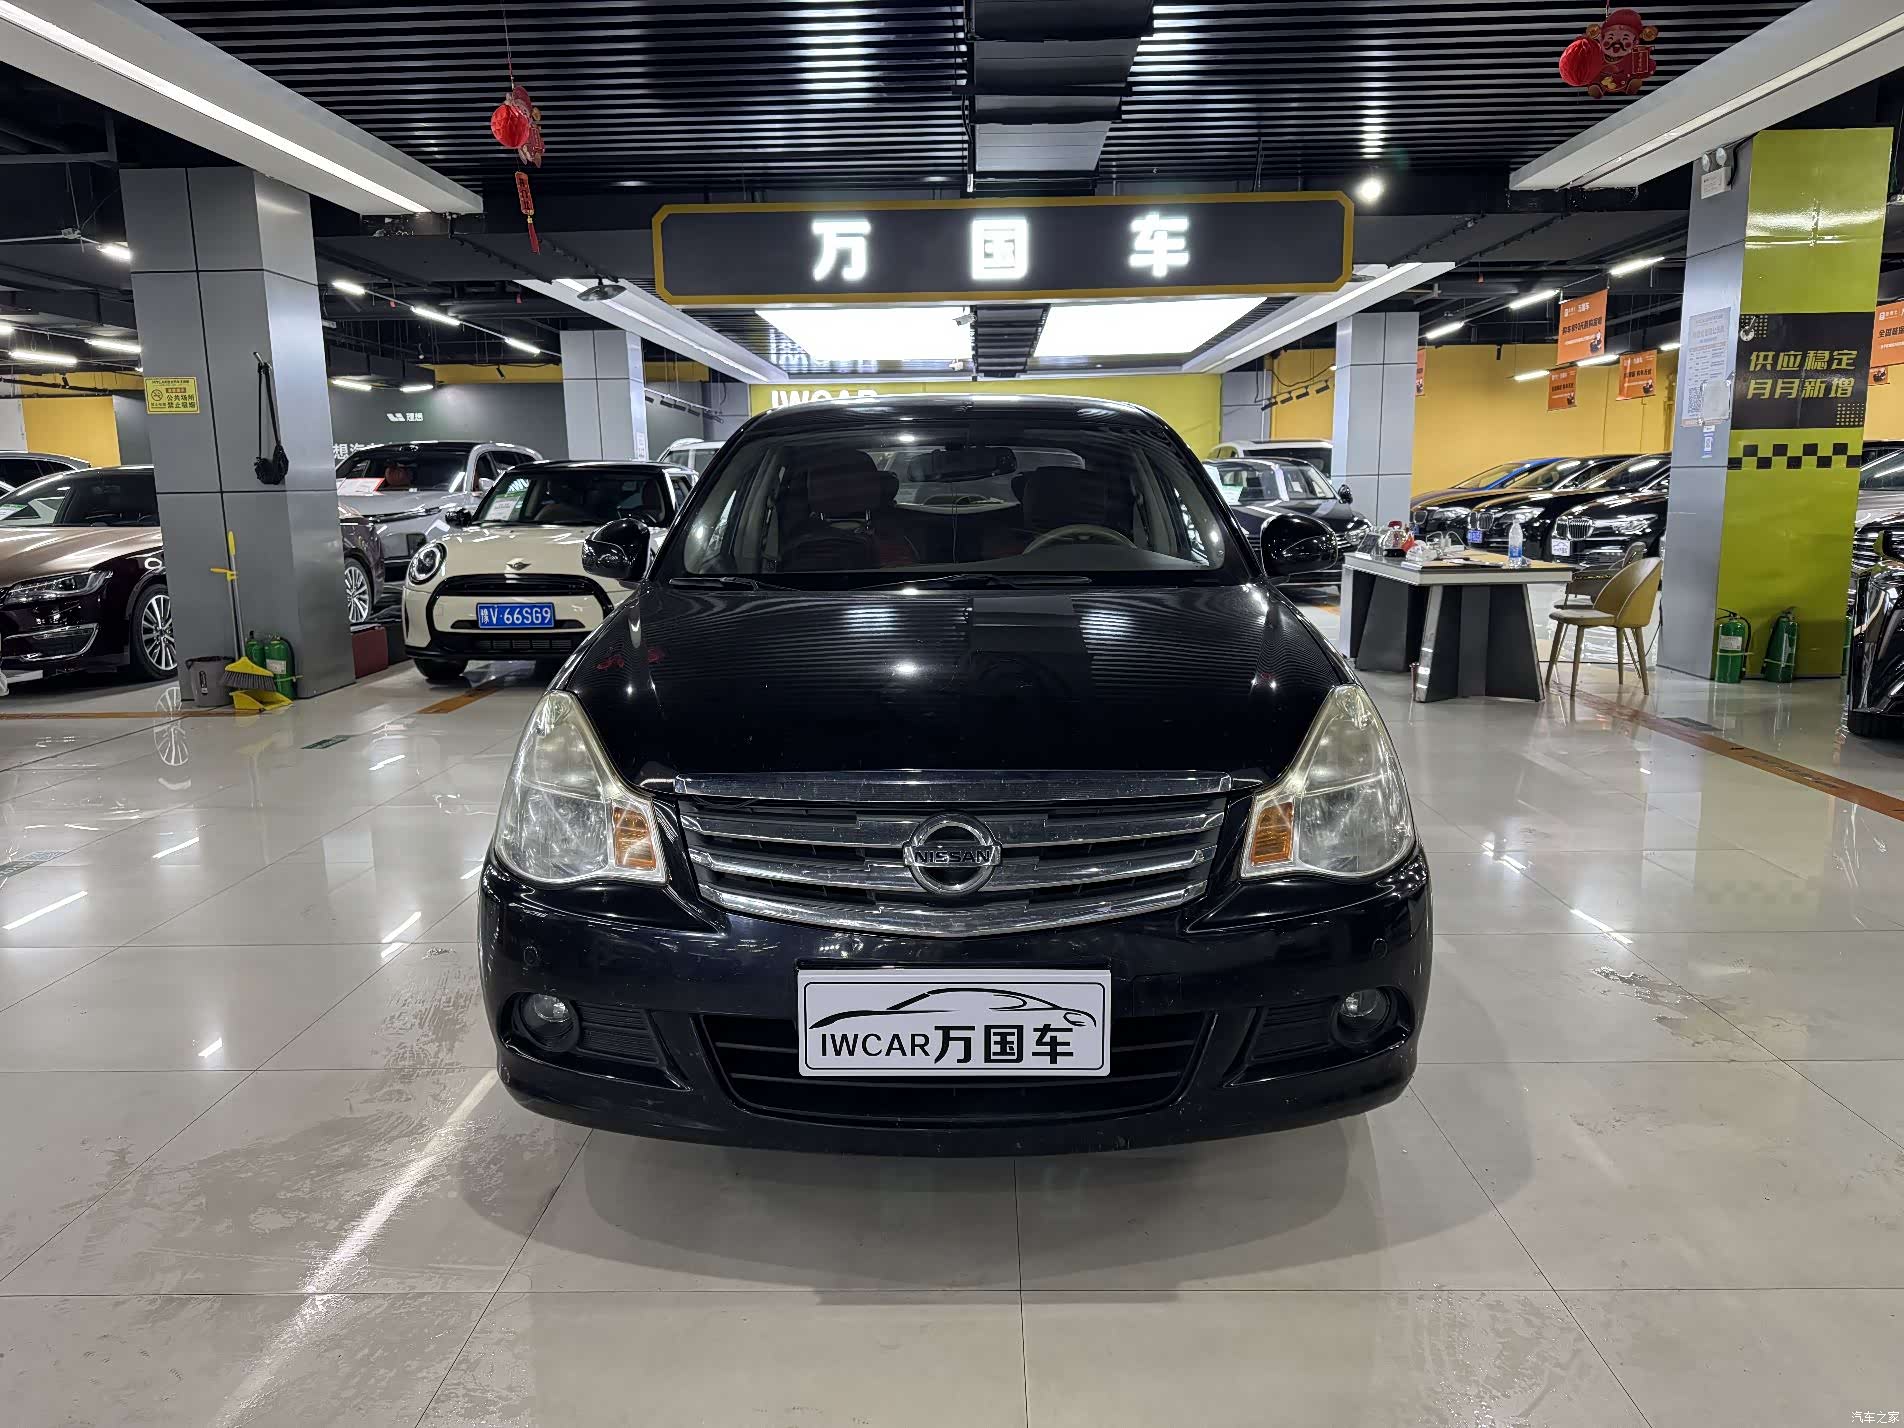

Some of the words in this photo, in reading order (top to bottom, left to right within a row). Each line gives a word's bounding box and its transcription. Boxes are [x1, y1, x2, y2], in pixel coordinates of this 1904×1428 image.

[811, 212, 1190, 283] 万国车
[1749, 350, 1858, 372] 供应稳定
[1746, 377, 1856, 400] 月月新增
[914, 850, 990, 864] NISSAN
